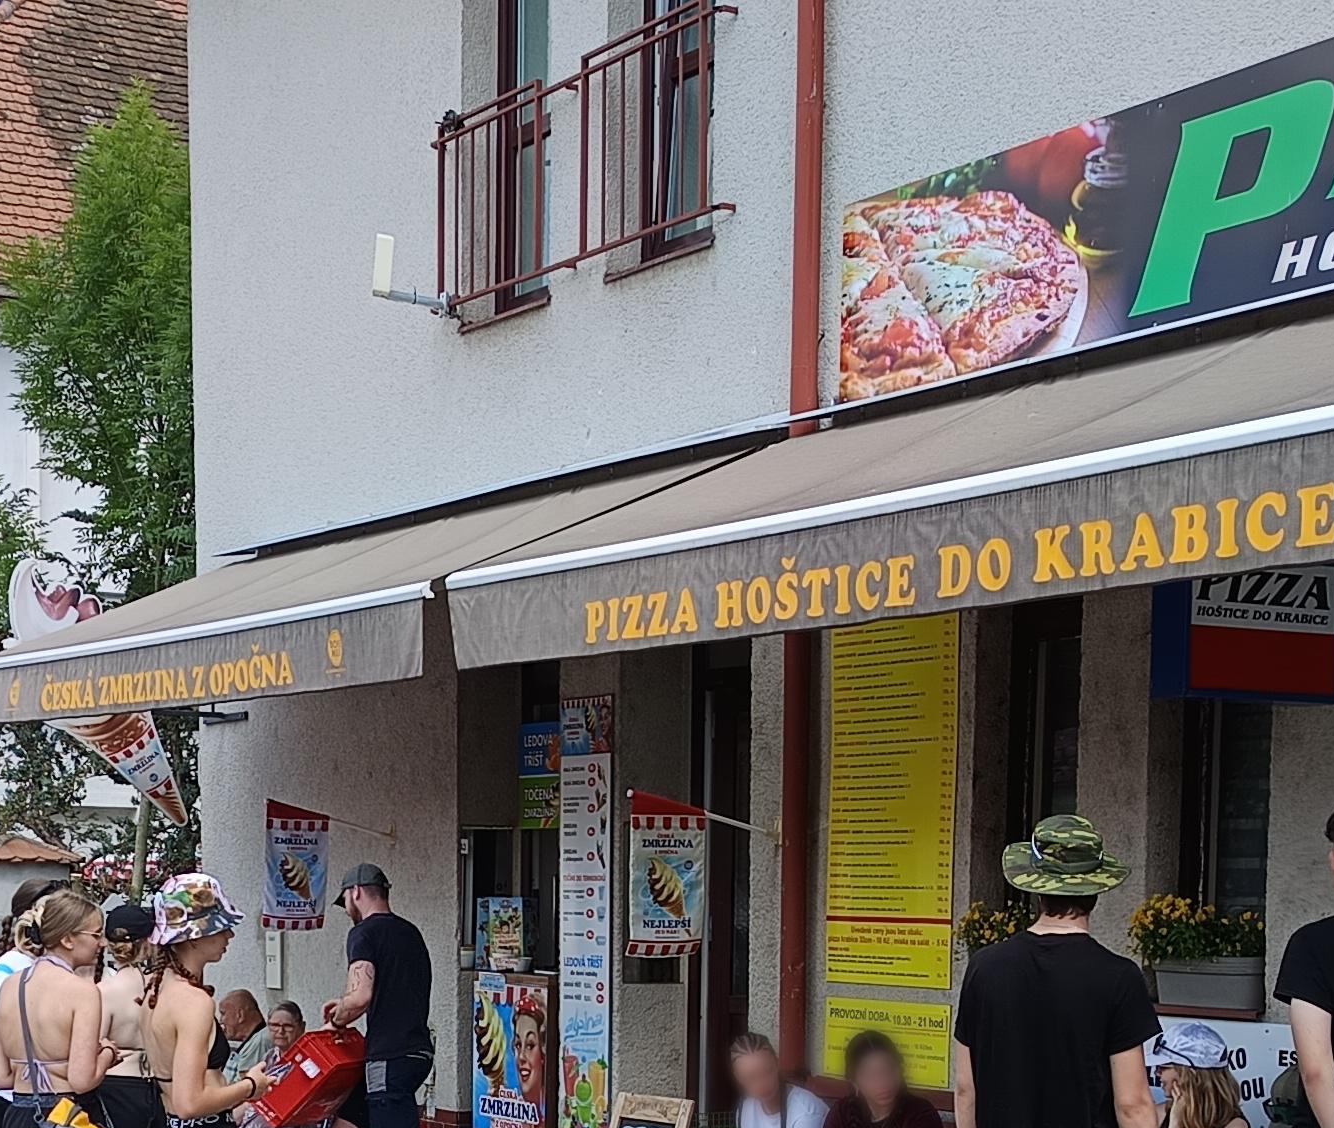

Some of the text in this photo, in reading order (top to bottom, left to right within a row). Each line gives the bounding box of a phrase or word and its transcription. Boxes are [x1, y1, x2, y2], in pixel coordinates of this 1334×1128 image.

[584, 586, 699, 645] PIZZA
[714, 555, 916, 629] HOŠTICE
[938, 537, 1012, 599] DO
[1196, 572, 1331, 611] PIZZA
[1196, 605, 1329, 626] HOŠTICE DO KRABICE
[40, 671, 96, 712] ČESKÁ
[98, 667, 188, 706] ZMRZLINA
[192, 665, 205, 698] Z
[209, 642, 295, 697] OPOČNA
[274, 837, 318, 846] ZMRZLINA
[642, 838, 694, 849] ZMRZLINA
[642, 917, 692, 930] NEJLEPŠÍ
[829, 1007, 867, 1021] PROVOZNÍ
[893, 1015, 912, 1026] 10.30
[917, 1017, 927, 1026] 21
[928, 1017, 944, 1028] hod
[480, 1097, 539, 1123] ZMRZLINA
